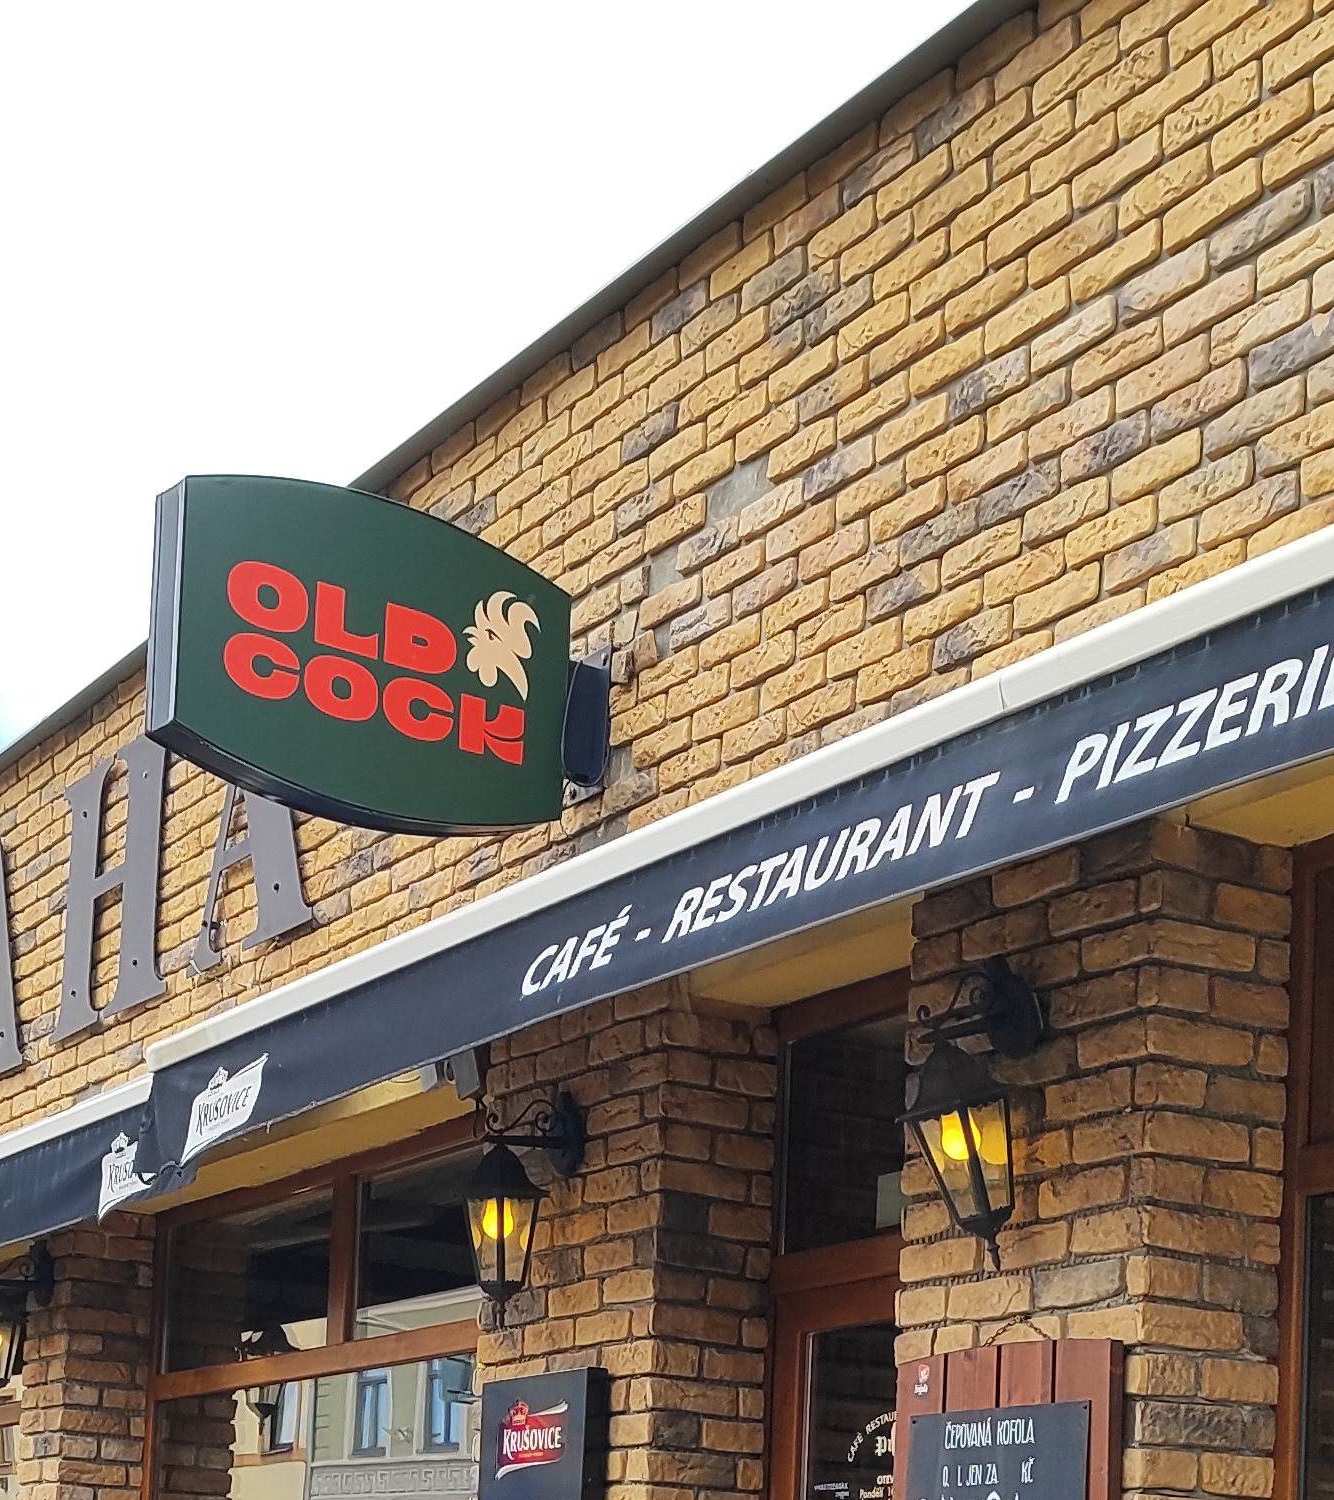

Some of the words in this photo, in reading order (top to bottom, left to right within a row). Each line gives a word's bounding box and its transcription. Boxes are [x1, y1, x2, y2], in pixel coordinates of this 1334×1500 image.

[226, 560, 457, 673] OLD
[223, 632, 526, 766] COCK
[520, 903, 633, 999] CAFÉ
[662, 771, 1002, 945] RESTAURANT
[503, 1425, 562, 1460] KRUŠOVICE
[944, 1416, 992, 1449] ČEPOVANÁ
[996, 1416, 1035, 1446] KOFOLA
[965, 1464, 982, 1487] JEN
[985, 1463, 1000, 1485] ZA
[1021, 1456, 1035, 1484] KČ
